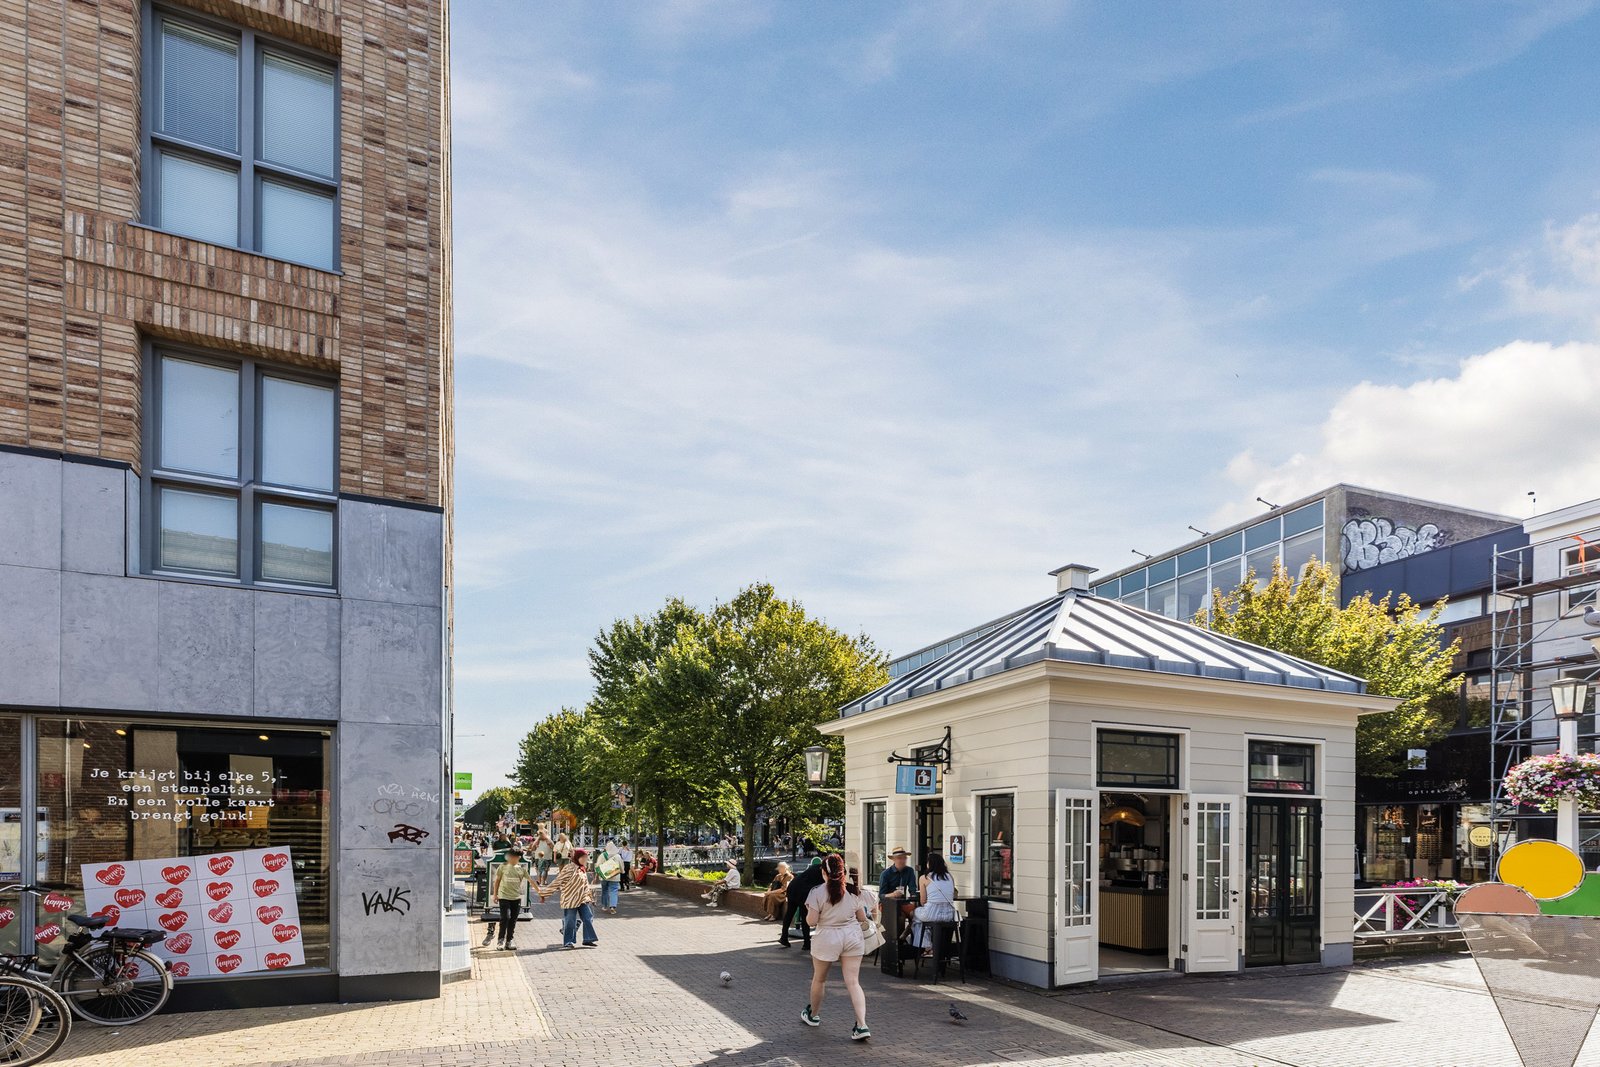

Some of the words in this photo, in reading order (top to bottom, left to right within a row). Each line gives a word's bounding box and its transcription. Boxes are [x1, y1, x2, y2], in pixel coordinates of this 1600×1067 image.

[90, 768, 109, 779] Je
[117, 769, 176, 781] krijgt
[184, 770, 211, 781] bij
[218, 770, 254, 782] elke
[122, 784, 152, 793] een
[161, 784, 262, 795] stempeltje.
[107, 796, 129, 807] En
[137, 797, 167, 807] een
[175, 797, 221, 808] volle
[228, 798, 276, 808] kaart
[131, 811, 192, 823] brengt
[200, 811, 253, 823] geluk!
[208, 859, 234, 871] happy
[263, 857, 288, 867] happy
[97, 867, 125, 884] happy
[162, 868, 191, 881] happy
[207, 885, 232, 896] happy
[254, 882, 278, 893] happy
[43, 895, 74, 911] happy
[116, 892, 145, 902] happy
[156, 891, 184, 907] happy
[209, 905, 233, 922] happy
[257, 908, 283, 919] happy
[160, 913, 188, 928] happy
